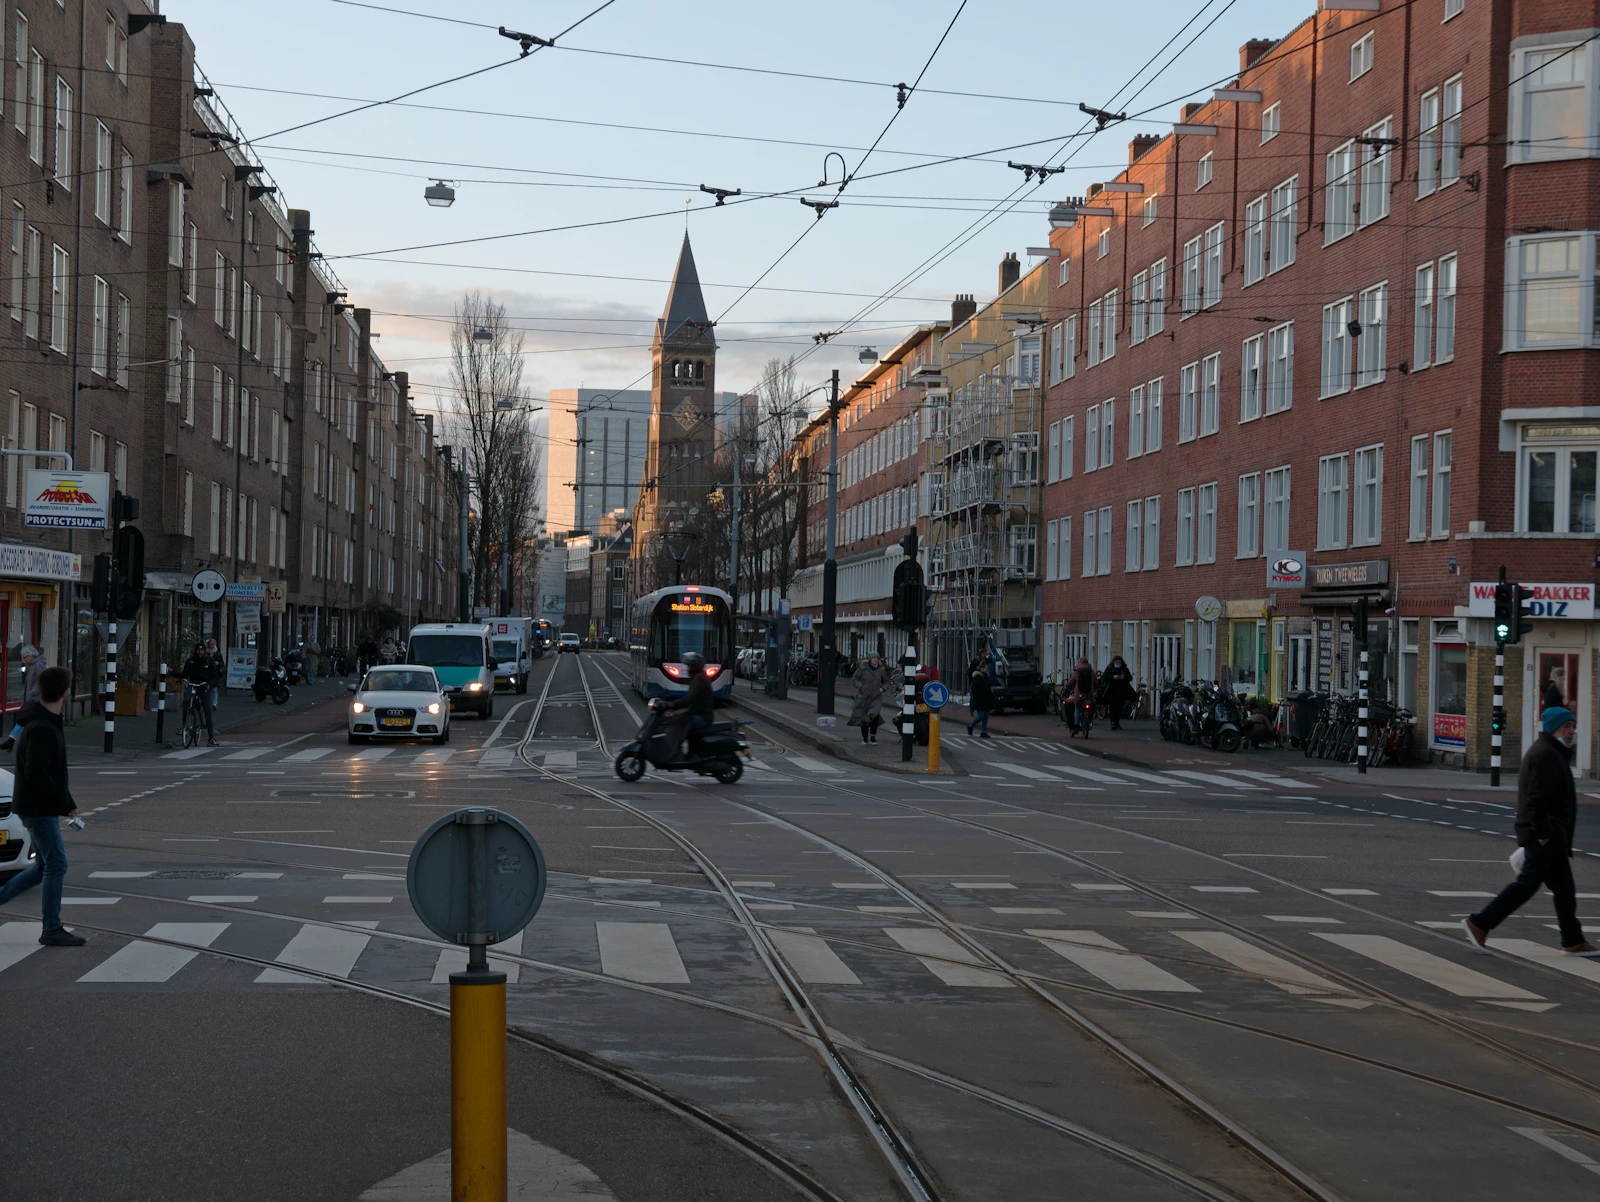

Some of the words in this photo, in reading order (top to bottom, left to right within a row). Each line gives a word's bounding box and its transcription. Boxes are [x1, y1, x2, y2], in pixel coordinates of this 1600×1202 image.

[27, 516, 104, 527] PROTECTSUN.nl
[1334, 565, 1367, 582] TWEEWIELERS
[1533, 586, 1590, 600] BAKKER
[696, 596, 702, 605] 19
[671, 603, 689, 611] Station
[690, 604, 714, 613] Sloterdijk
